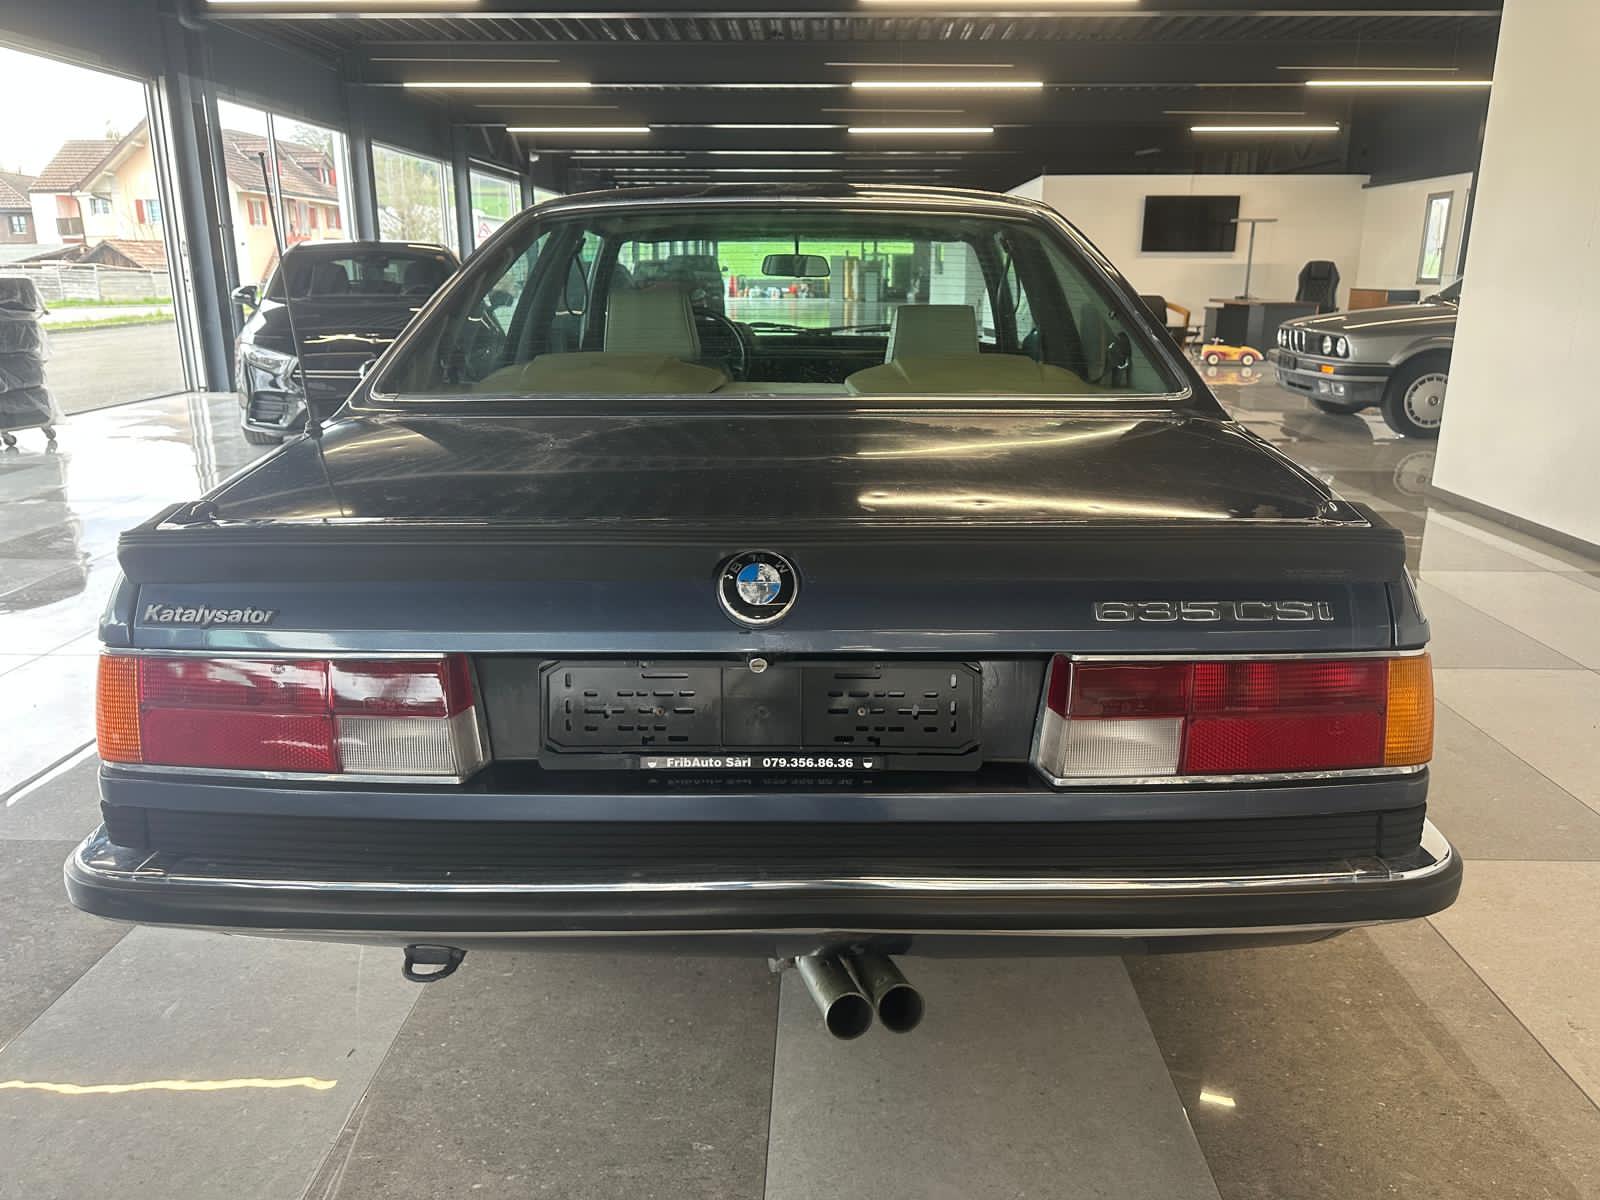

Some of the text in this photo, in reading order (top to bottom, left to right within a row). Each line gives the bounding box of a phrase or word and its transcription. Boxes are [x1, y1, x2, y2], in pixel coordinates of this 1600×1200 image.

[143, 604, 274, 625] Katalysator
[1094, 600, 1221, 622] 635
[666, 757, 722, 768] FribAuto
[762, 757, 854, 769] 079.356.86.36
